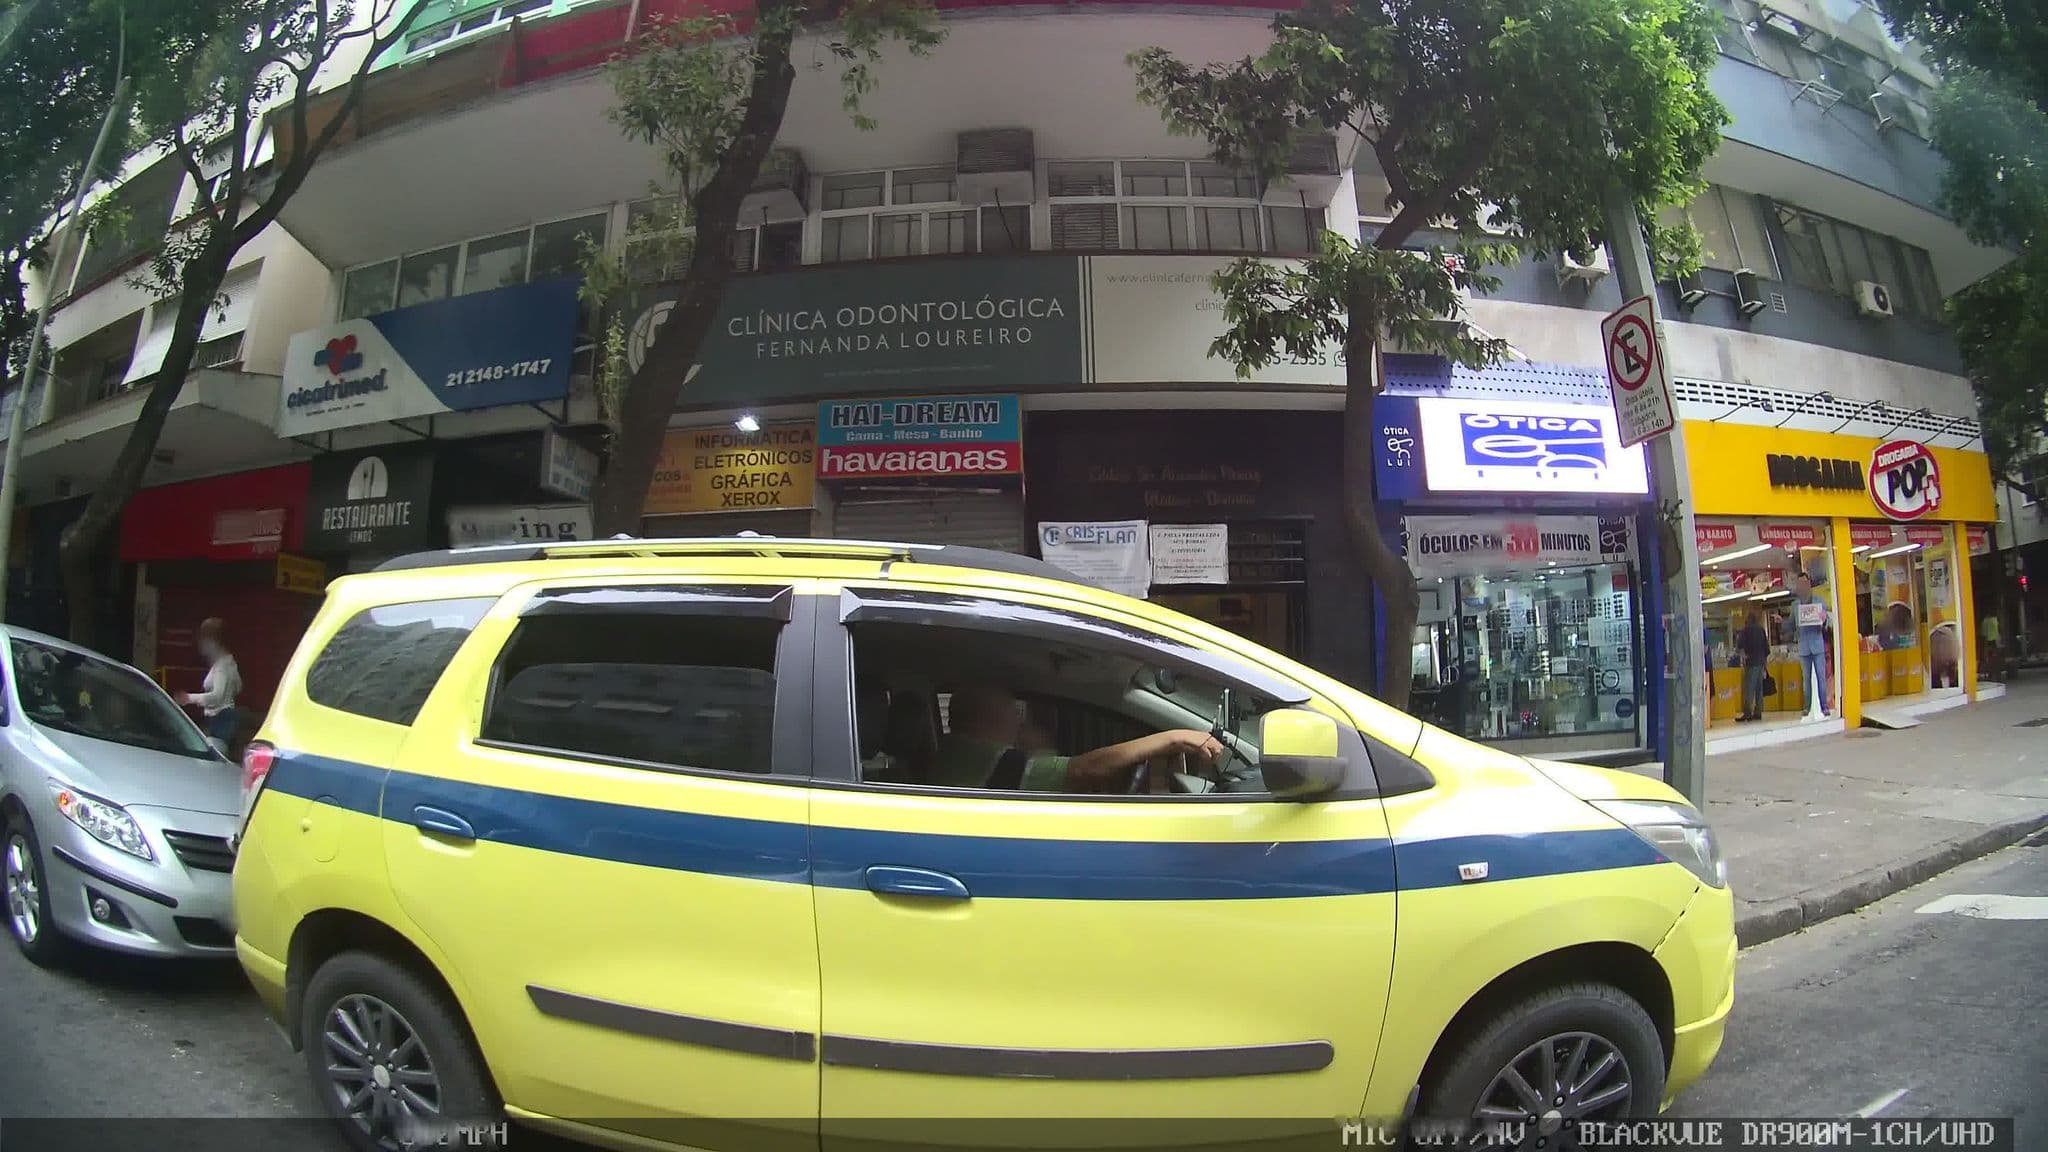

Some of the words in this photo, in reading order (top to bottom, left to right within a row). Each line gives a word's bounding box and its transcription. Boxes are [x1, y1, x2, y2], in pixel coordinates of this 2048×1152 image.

[727, 308, 828, 337] CLÍNICA
[836, 293, 1065, 327] ODONTOLÓGICA
[756, 333, 891, 359] FERNANDA
[900, 326, 1032, 349] LOUREIRO
[445, 370, 464, 387] 21
[465, 359, 552, 384] 2148-1747
[831, 400, 1001, 428] HAI-DREAM
[1383, 425, 1410, 436] ÓTICA
[694, 449, 813, 470] ELETRÔNICOS
[822, 448, 1008, 473] havaianas
[710, 469, 793, 490] GRÁFICA
[1887, 457, 1929, 506] POP
[721, 490, 781, 507] XEROX
[322, 501, 412, 531] RESTAURANTE
[1420, 532, 1480, 555] ÓCULOS
[1540, 532, 1592, 552] MINUTOS
